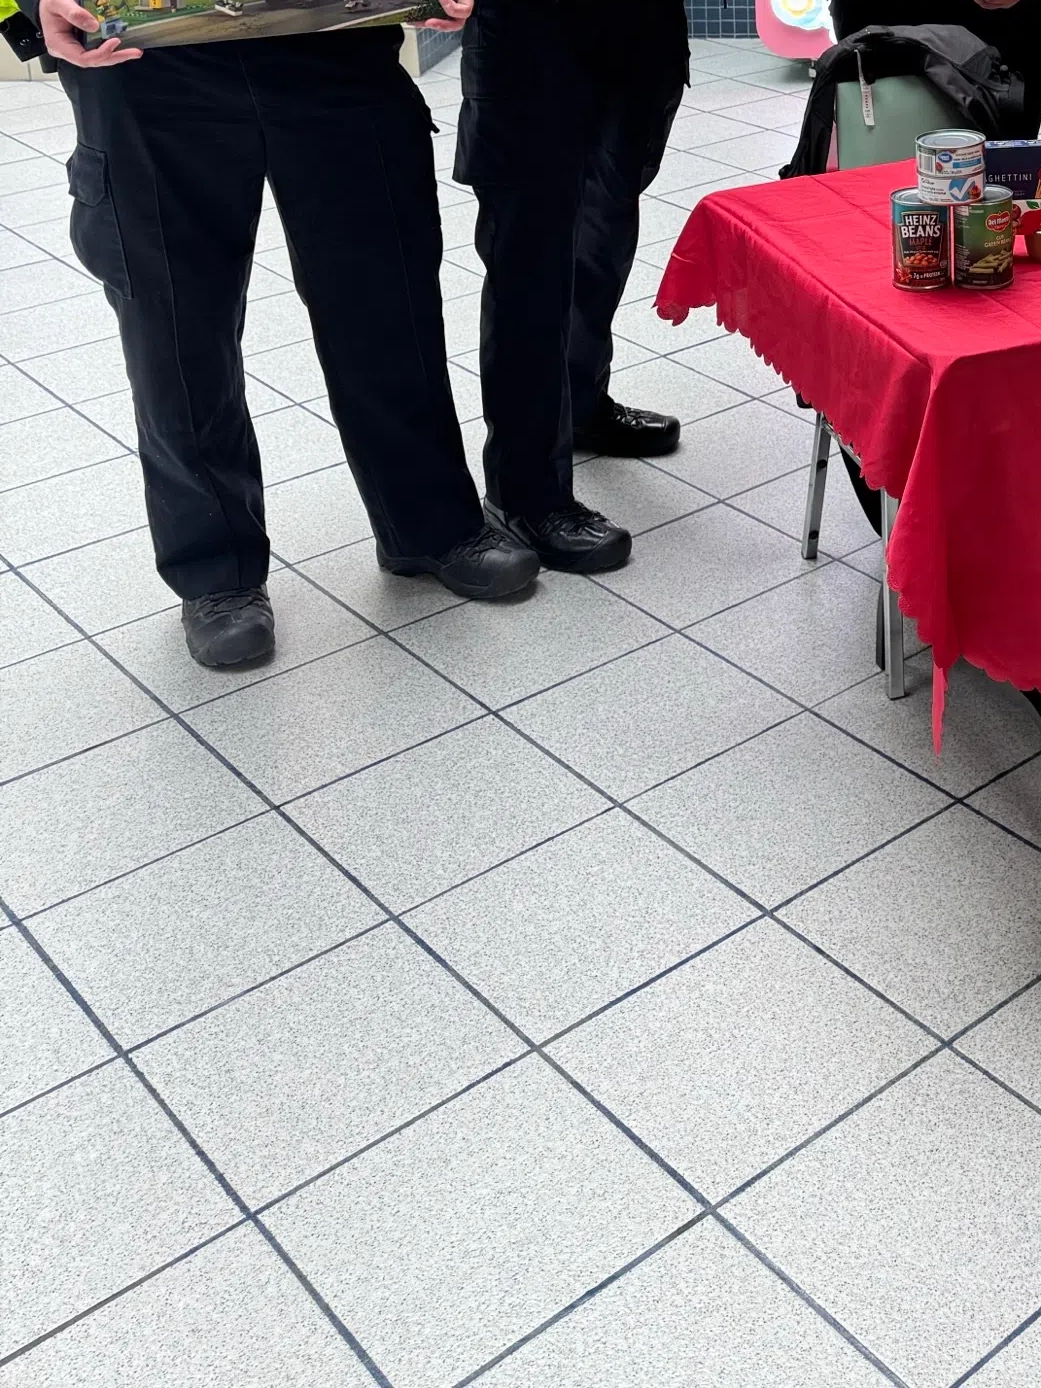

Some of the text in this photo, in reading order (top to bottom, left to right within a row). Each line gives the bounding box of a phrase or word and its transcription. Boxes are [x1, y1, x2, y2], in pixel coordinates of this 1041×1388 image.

[984, 173, 1033, 183] GHETTINI
[905, 214, 938, 226] HEINZ
[901, 225, 941, 238] BEANS
[909, 237, 932, 246] MAPLE
